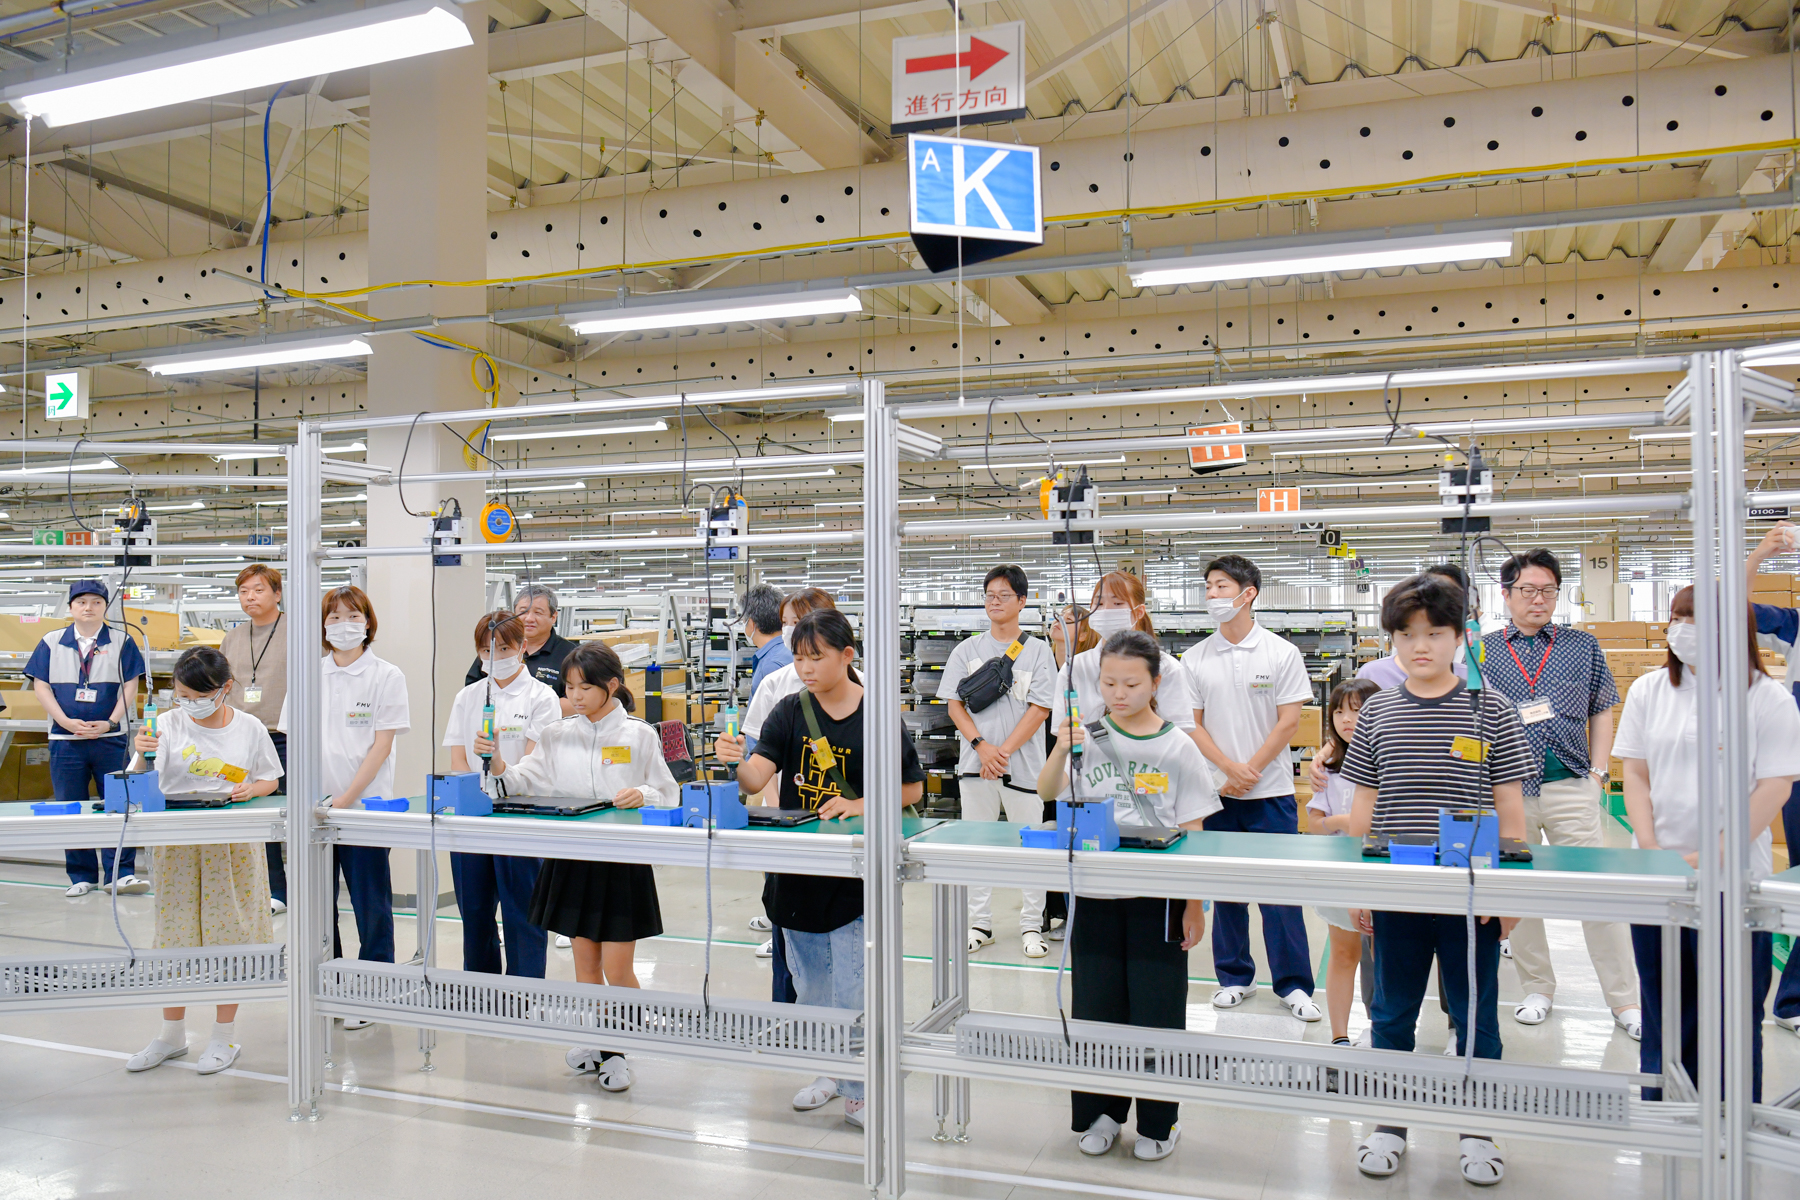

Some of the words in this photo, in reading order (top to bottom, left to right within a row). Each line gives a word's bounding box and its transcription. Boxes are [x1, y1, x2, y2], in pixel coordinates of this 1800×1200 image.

[904, 86, 1007, 117] 進行方向
[921, 147, 941, 172] A
[952, 145, 1013, 230] K
[1260, 491, 1267, 499] A
[1270, 491, 1288, 512] H
[42, 531, 58, 545] G
[72, 533, 85, 545] H
[1589, 557, 1608, 569] 15
[736, 574, 748, 584] 13
